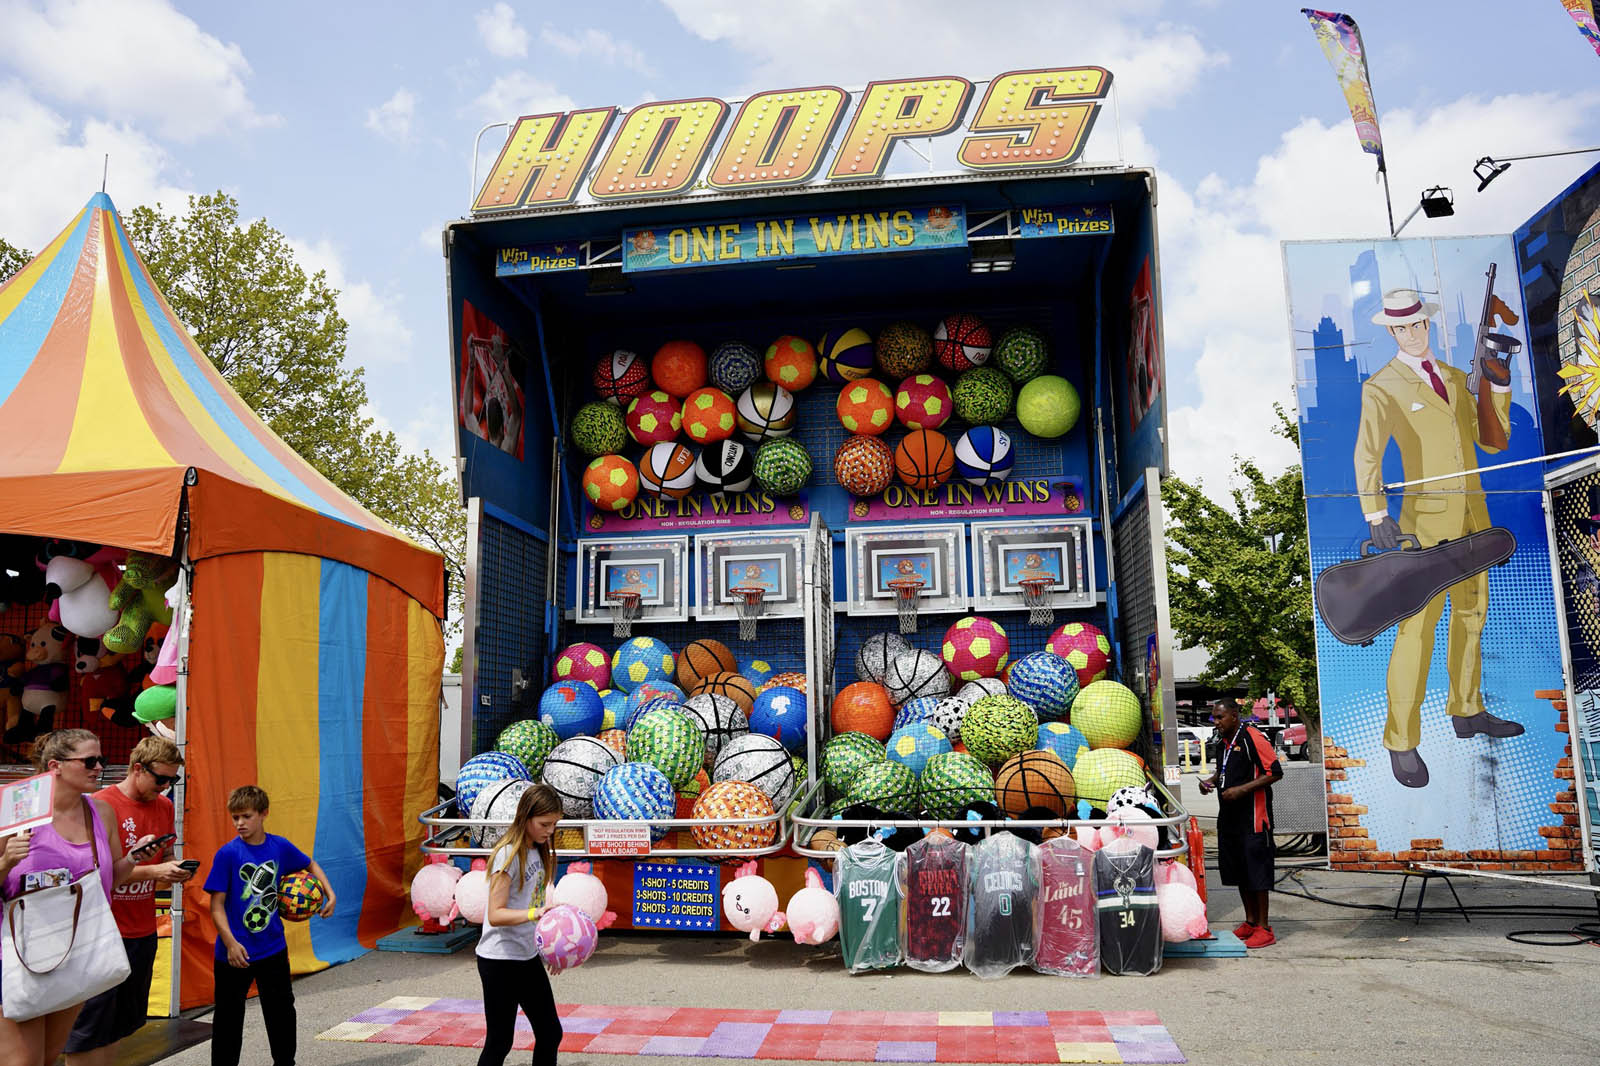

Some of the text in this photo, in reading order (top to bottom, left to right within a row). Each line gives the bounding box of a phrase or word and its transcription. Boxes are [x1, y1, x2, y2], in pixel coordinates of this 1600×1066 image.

[472, 66, 1114, 213] HOOPS
[1022, 208, 1053, 225] Win
[1057, 218, 1110, 234] Prizes
[668, 210, 914, 265] ONE IN WINS
[502, 247, 528, 264] Win
[531, 255, 577, 271] Prizes
[945, 483, 974, 506] IN
[982, 479, 1050, 503] WINS
[676, 494, 705, 518] IN
[709, 491, 775, 515] WINS
[671, 879, 677, 889] 5
[677, 879, 710, 890] CREDITS
[849, 879, 888, 899] BOSTON
[984, 870, 1023, 893] CELTICS
[1044, 876, 1084, 903] Land
[636, 889, 667, 901] 3-SHOTS
[672, 892, 681, 902] 10
[681, 892, 714, 904] CREDITS
[931, 896, 952, 917] 22
[999, 893, 1012, 916] 0
[636, 902, 641, 912] 7
[641, 902, 666, 914] SHOTS
[671, 904, 680, 915] 20
[681, 905, 713, 916] CREDITS
[861, 898, 877, 922] 7
[1057, 904, 1083, 929] 45
[1119, 909, 1136, 928] 34
